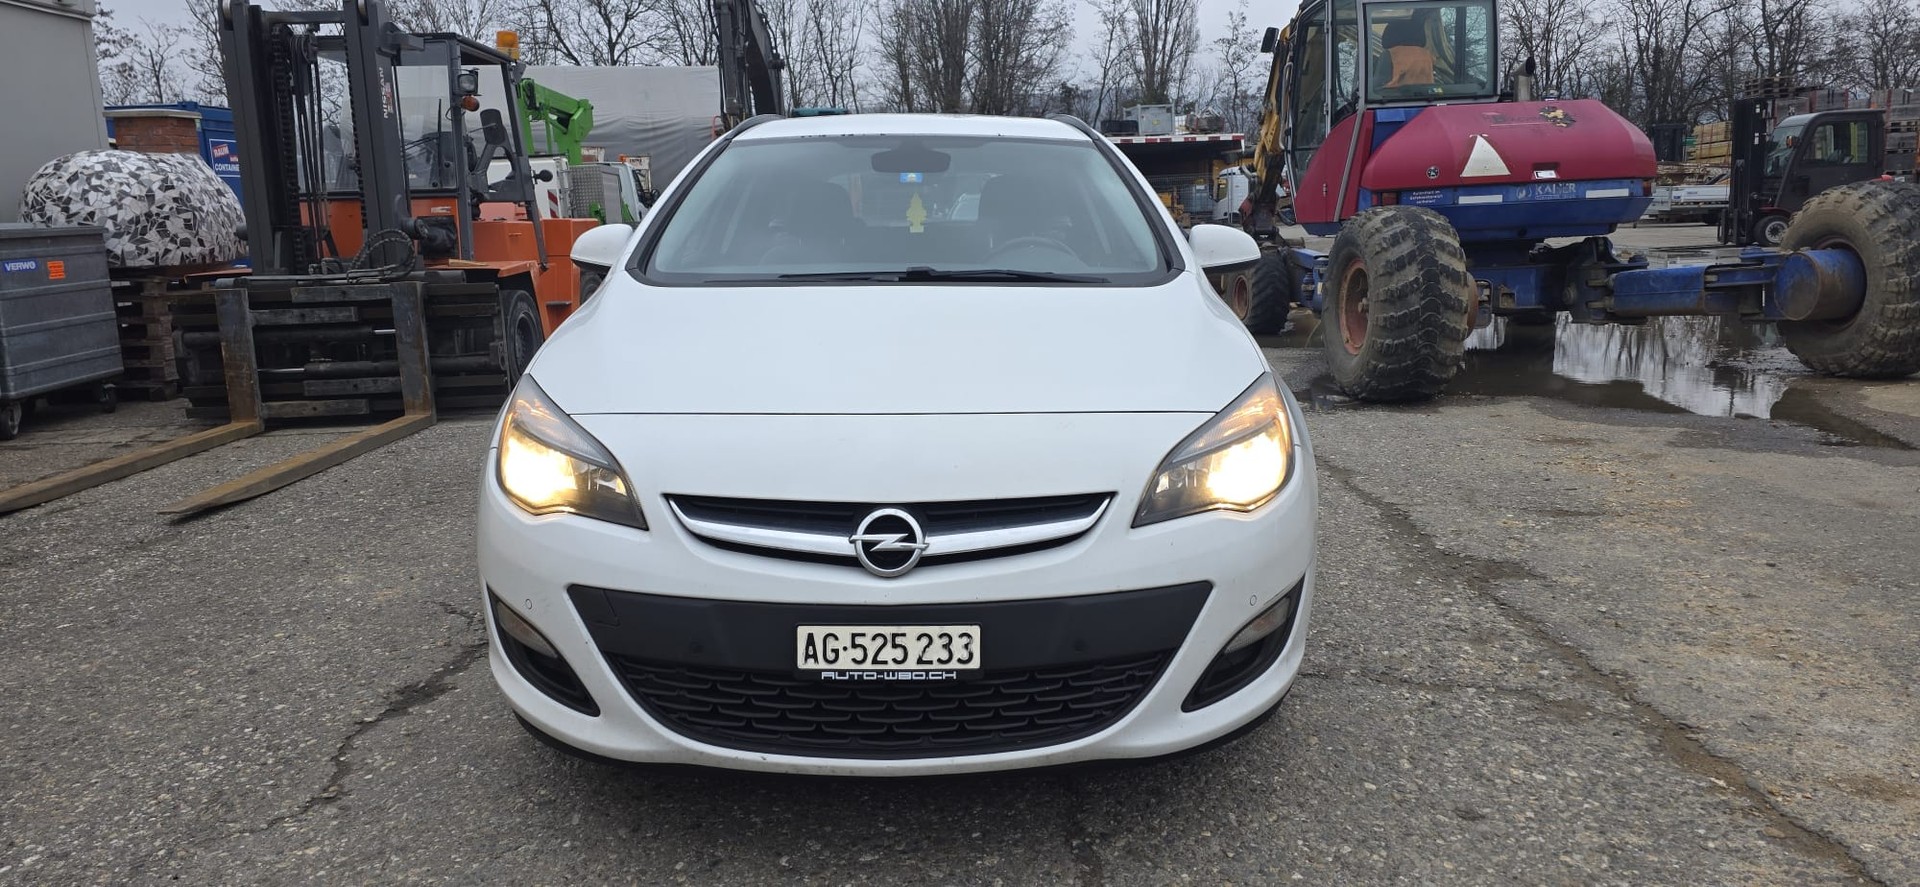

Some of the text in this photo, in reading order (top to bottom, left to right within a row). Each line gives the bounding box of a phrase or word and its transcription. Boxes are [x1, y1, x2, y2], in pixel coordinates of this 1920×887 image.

[379, 67, 388, 118] NISSAN
[4, 261, 37, 271] VERWO
[916, 632, 974, 665] 233
